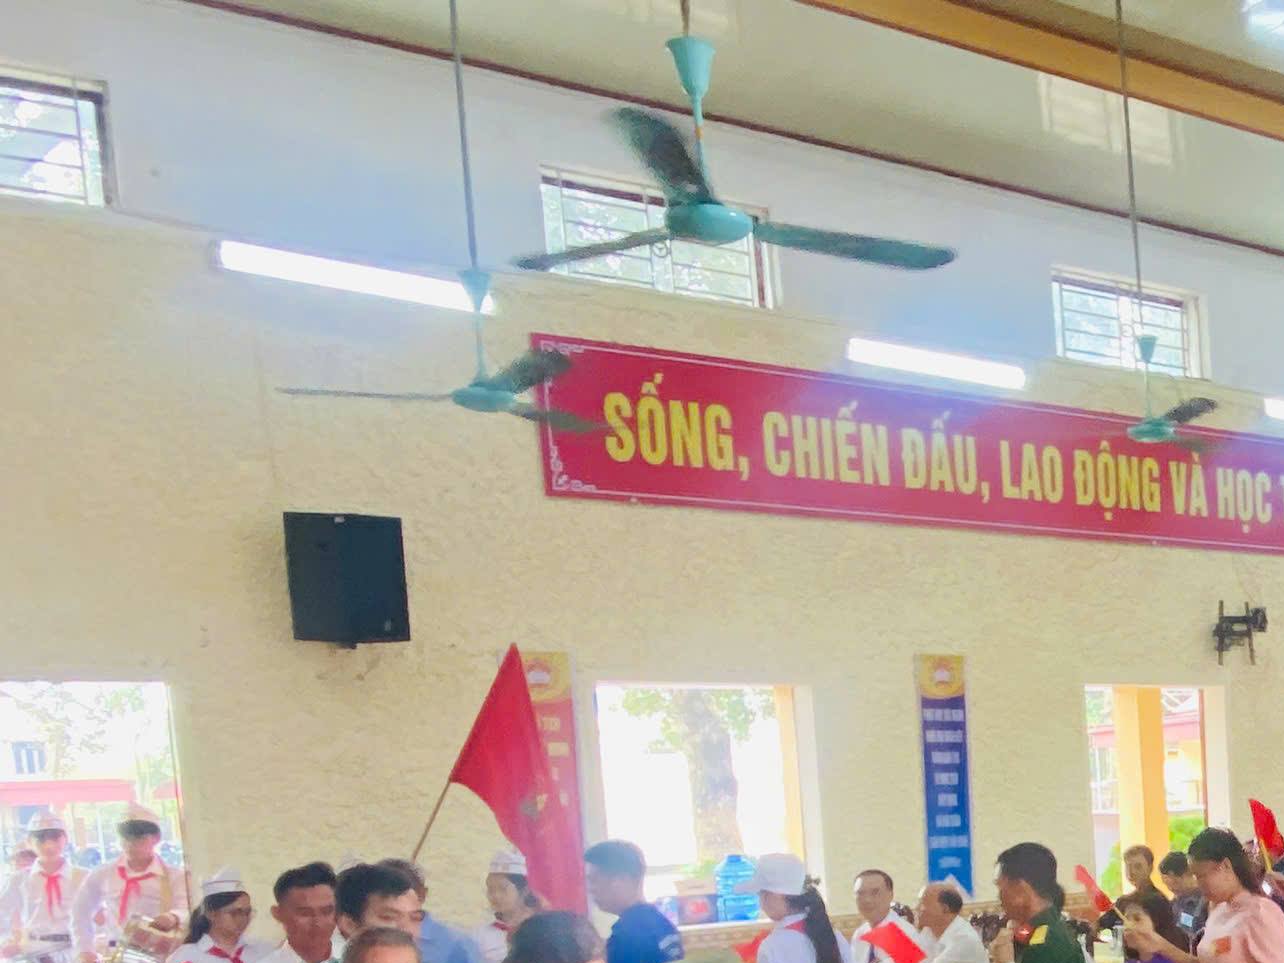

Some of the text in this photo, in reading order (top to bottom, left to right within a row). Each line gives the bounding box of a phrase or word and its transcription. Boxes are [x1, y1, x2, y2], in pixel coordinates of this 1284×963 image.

[603, 372, 750, 481] SỐNG,
[763, 400, 892, 487] CHIẾN
[901, 409, 991, 504] ĐẤU,
[1000, 439, 1065, 504] LAO
[1073, 440, 1162, 521] ĐỘNG
[1168, 451, 1209, 518] VÀ
[1215, 466, 1273, 534] HỌC
